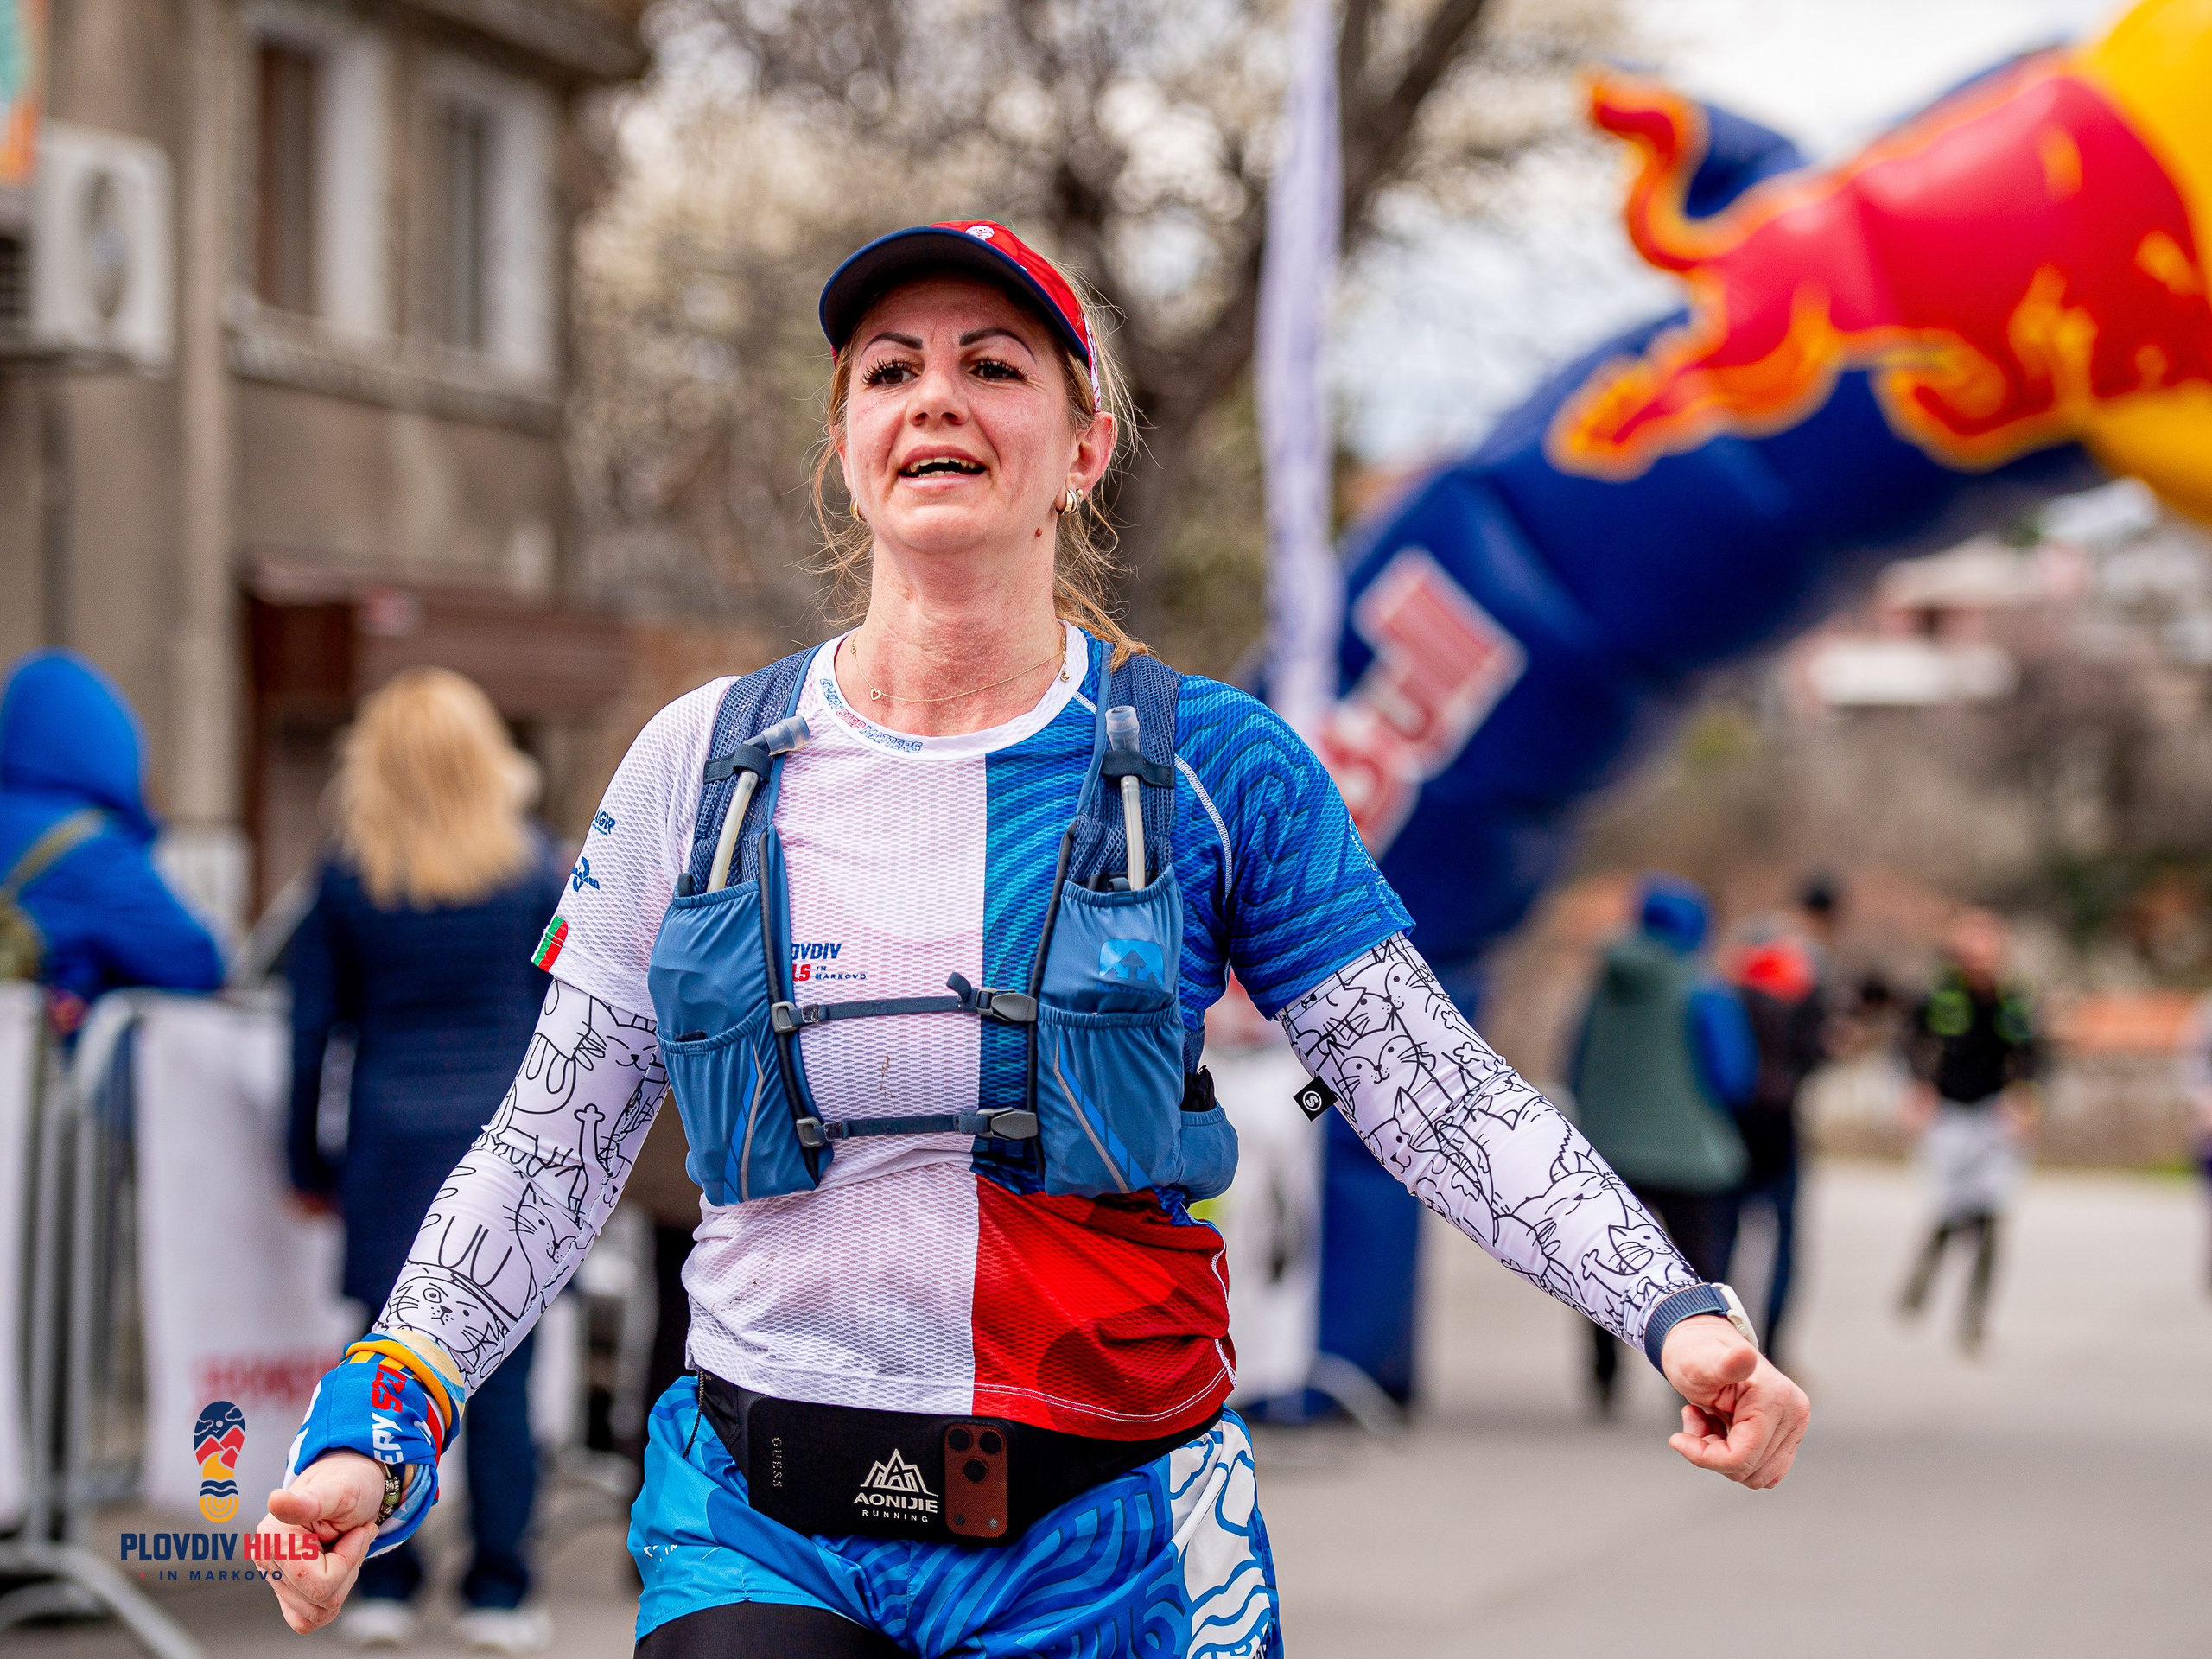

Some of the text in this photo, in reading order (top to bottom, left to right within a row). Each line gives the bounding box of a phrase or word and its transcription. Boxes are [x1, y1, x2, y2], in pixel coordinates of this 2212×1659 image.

[836, 709, 867, 728] STEP
[859, 725, 924, 754] MATTERS
[791, 942, 842, 960] OVDIV
[371, 1411, 404, 1465] ERY
[772, 1437, 783, 1488] GUESS
[853, 1492, 938, 1514] AONIJIE
[861, 1509, 929, 1523] RUNNING
